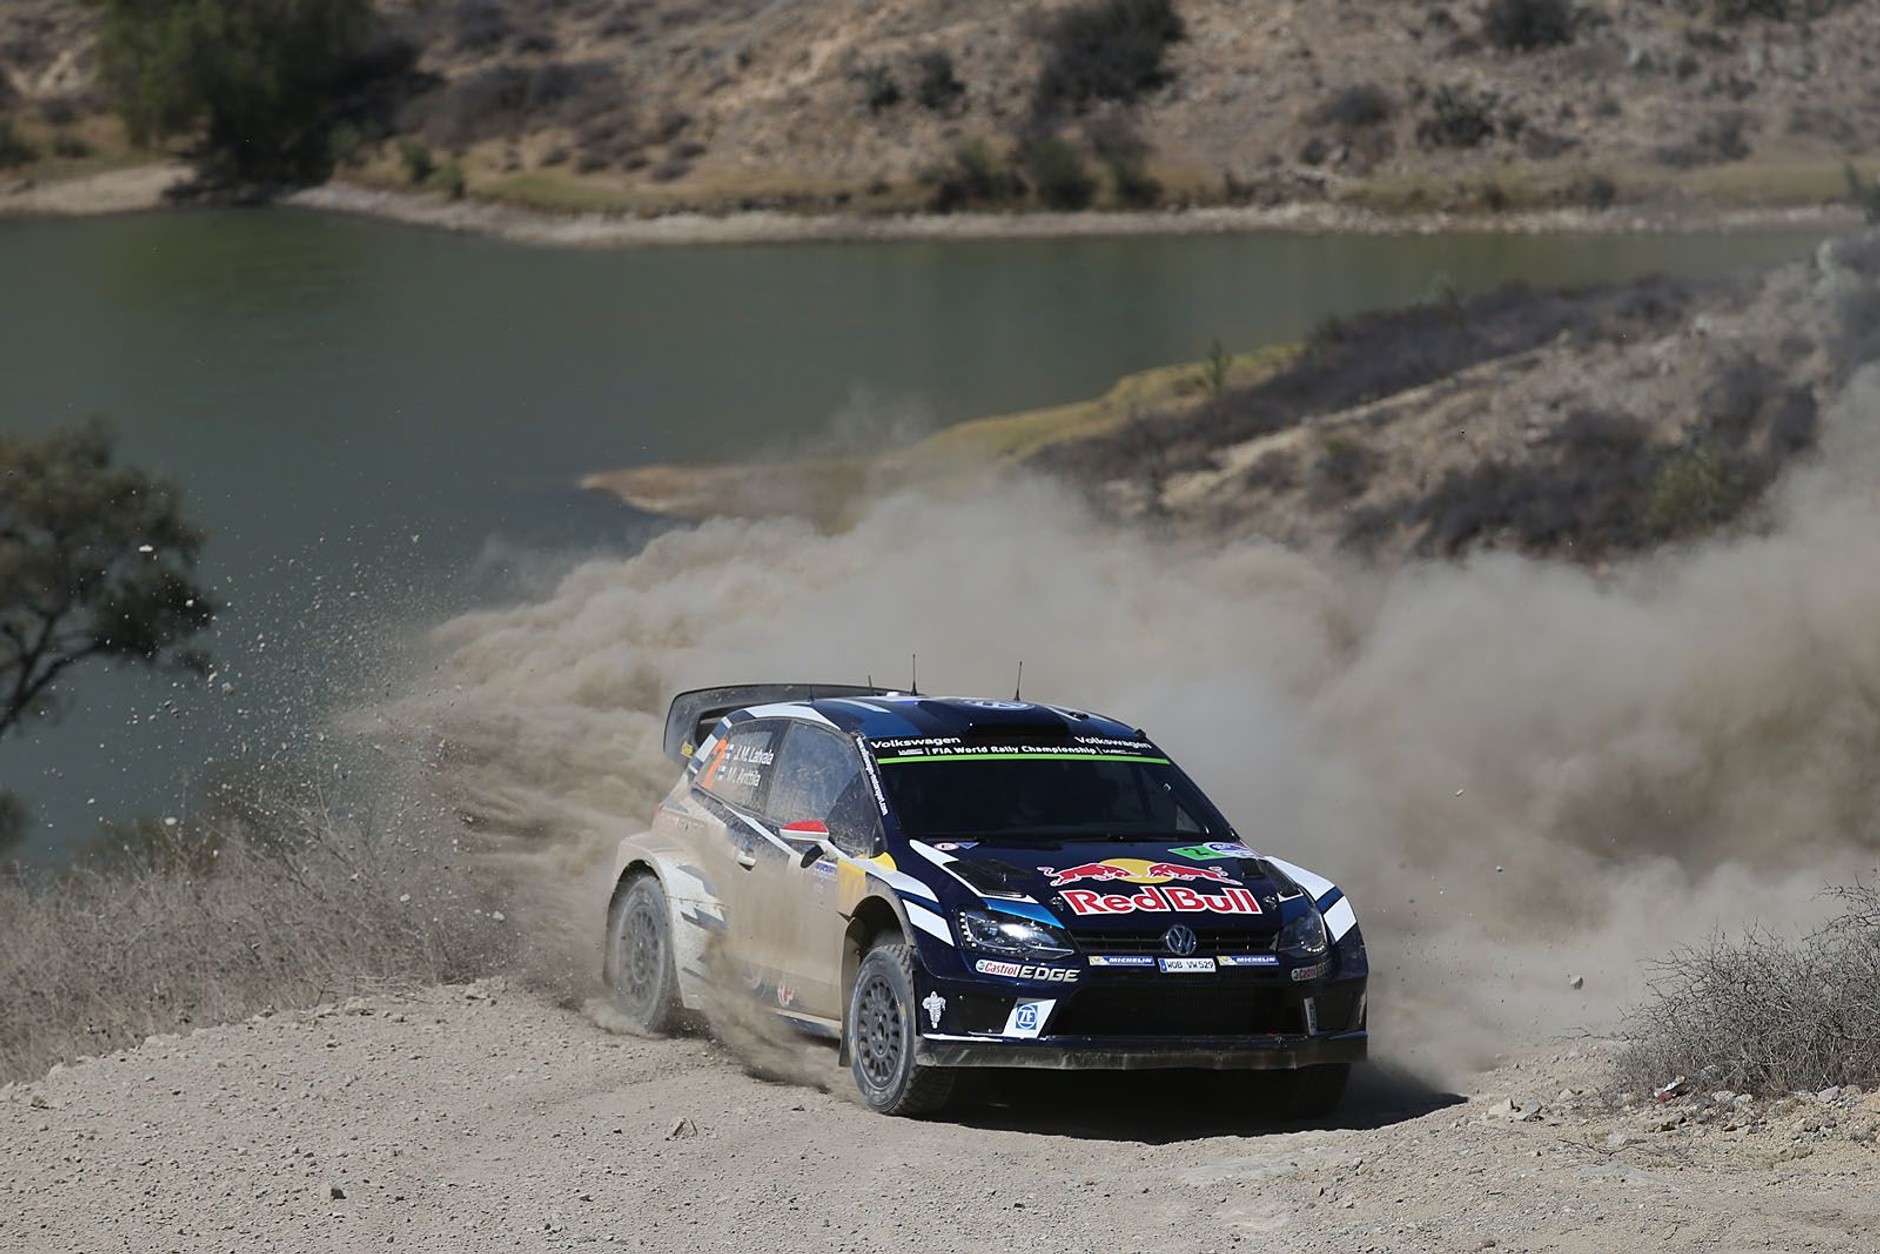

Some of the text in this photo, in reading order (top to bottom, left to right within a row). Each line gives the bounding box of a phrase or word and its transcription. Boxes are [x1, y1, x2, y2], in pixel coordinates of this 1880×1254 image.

[871, 737, 961, 749] Volkswagen
[1074, 736, 1152, 749] Volkswagen
[953, 746, 988, 754] World
[990, 745, 1019, 754] Rally
[1021, 745, 1097, 755] Championship
[703, 738, 728, 790] 2
[1059, 886, 1263, 915] Red Bull
[1166, 960, 1183, 969] WOB
[984, 962, 1081, 982] Castrol EDGE
[1019, 1011, 1034, 1024] ZF
